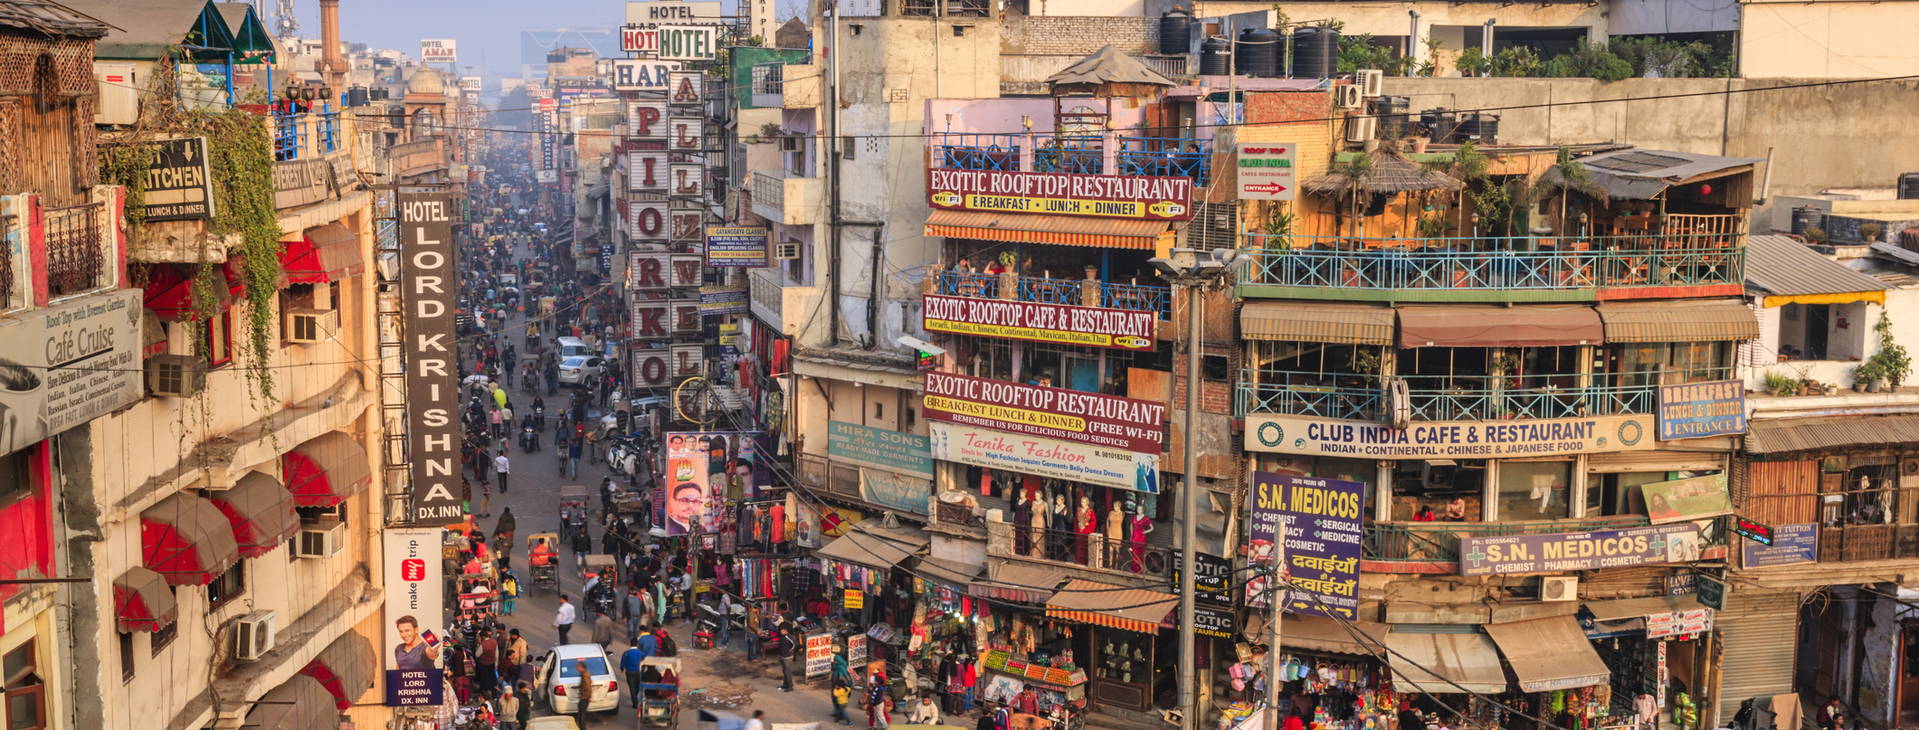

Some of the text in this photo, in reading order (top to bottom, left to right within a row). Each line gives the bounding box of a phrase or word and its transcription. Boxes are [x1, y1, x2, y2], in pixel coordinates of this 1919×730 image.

[650, 6, 694, 18] HOTEL
[624, 31, 658, 49] HOT
[660, 29, 714, 58] HOTEL
[424, 48, 454, 56] AMAN
[464, 80, 480, 88] HOTEL
[617, 65, 680, 87] HAR
[1240, 159, 1290, 168] CLUB INDIA
[144, 166, 204, 189] ITCHEN
[931, 170, 1188, 200] EXOTIC ROOFTOP RESTAURANT
[148, 206, 171, 217] LUNCH
[180, 204, 206, 216] DINNER
[403, 201, 449, 223] HOTEL
[973, 196, 1136, 216] BREAKFAST LUNCH DINNER
[46, 313, 62, 329] Roof
[62, 311, 72, 328] Top
[925, 296, 1152, 337] EXOTIC ROOFTOP CAFE & RESTAURANT
[46, 324, 114, 366] Café Cruise
[1092, 334, 1106, 343] Thai
[413, 227, 454, 502] LORD KRISHNA
[48, 390, 66, 404] Indian,
[926, 373, 1164, 426] EXOTIC ROOFTOP RESTAURANT
[1664, 382, 1740, 404] BREAKFAST
[1664, 401, 1742, 420] LUNCH & DINNER
[926, 396, 1162, 444] BREAKFAST LUNCH & DINNER (FREE WI-FI)
[1676, 420, 1732, 435] ENTRANCE
[837, 424, 924, 448] HIRA SONS
[952, 414, 994, 427] REMEMBER
[1007, 424, 1023, 432] FOR
[1024, 426, 1066, 438] DELICIOUS
[1067, 432, 1090, 440] FOOD
[1090, 434, 1129, 447] SERVICES
[1308, 423, 1354, 442] CLUB
[1360, 426, 1409, 444] INDIA
[1415, 427, 1460, 445] CAFE
[1467, 426, 1479, 443] &
[1486, 421, 1596, 443] RESTAURANT
[883, 449, 924, 464] GARMENTS
[963, 432, 1015, 454] Tanika
[1022, 440, 1087, 464] Fashion
[1320, 442, 1583, 456] INDIAN CONTINENTAL CHINESE & JAPANESE FOOD
[986, 452, 998, 460] High
[1000, 454, 1020, 462] Fashion
[1042, 460, 1068, 470] Garments
[1070, 464, 1084, 473] Belly
[1085, 466, 1102, 476] Dance
[1104, 470, 1124, 479] Dresses
[1258, 482, 1359, 520] S.N. MEDICOS
[1262, 512, 1296, 525] CHEMIST
[1322, 519, 1361, 534] SERGICAL
[1262, 523, 1304, 538] PHAACY
[1322, 531, 1360, 544] MEDICINE
[1784, 526, 1811, 534] TUITION
[410, 540, 419, 558] trip
[1286, 539, 1325, 553] COSMETIC
[1486, 535, 1648, 562] S.N. MEDICOS
[1495, 562, 1536, 573] CHEMIST
[1544, 558, 1592, 571] PHARMACY
[1600, 556, 1642, 567] COSMETIC
[410, 582, 418, 610] make
[1194, 628, 1232, 639] TAURANT
[398, 688, 432, 696] KRISHNA
